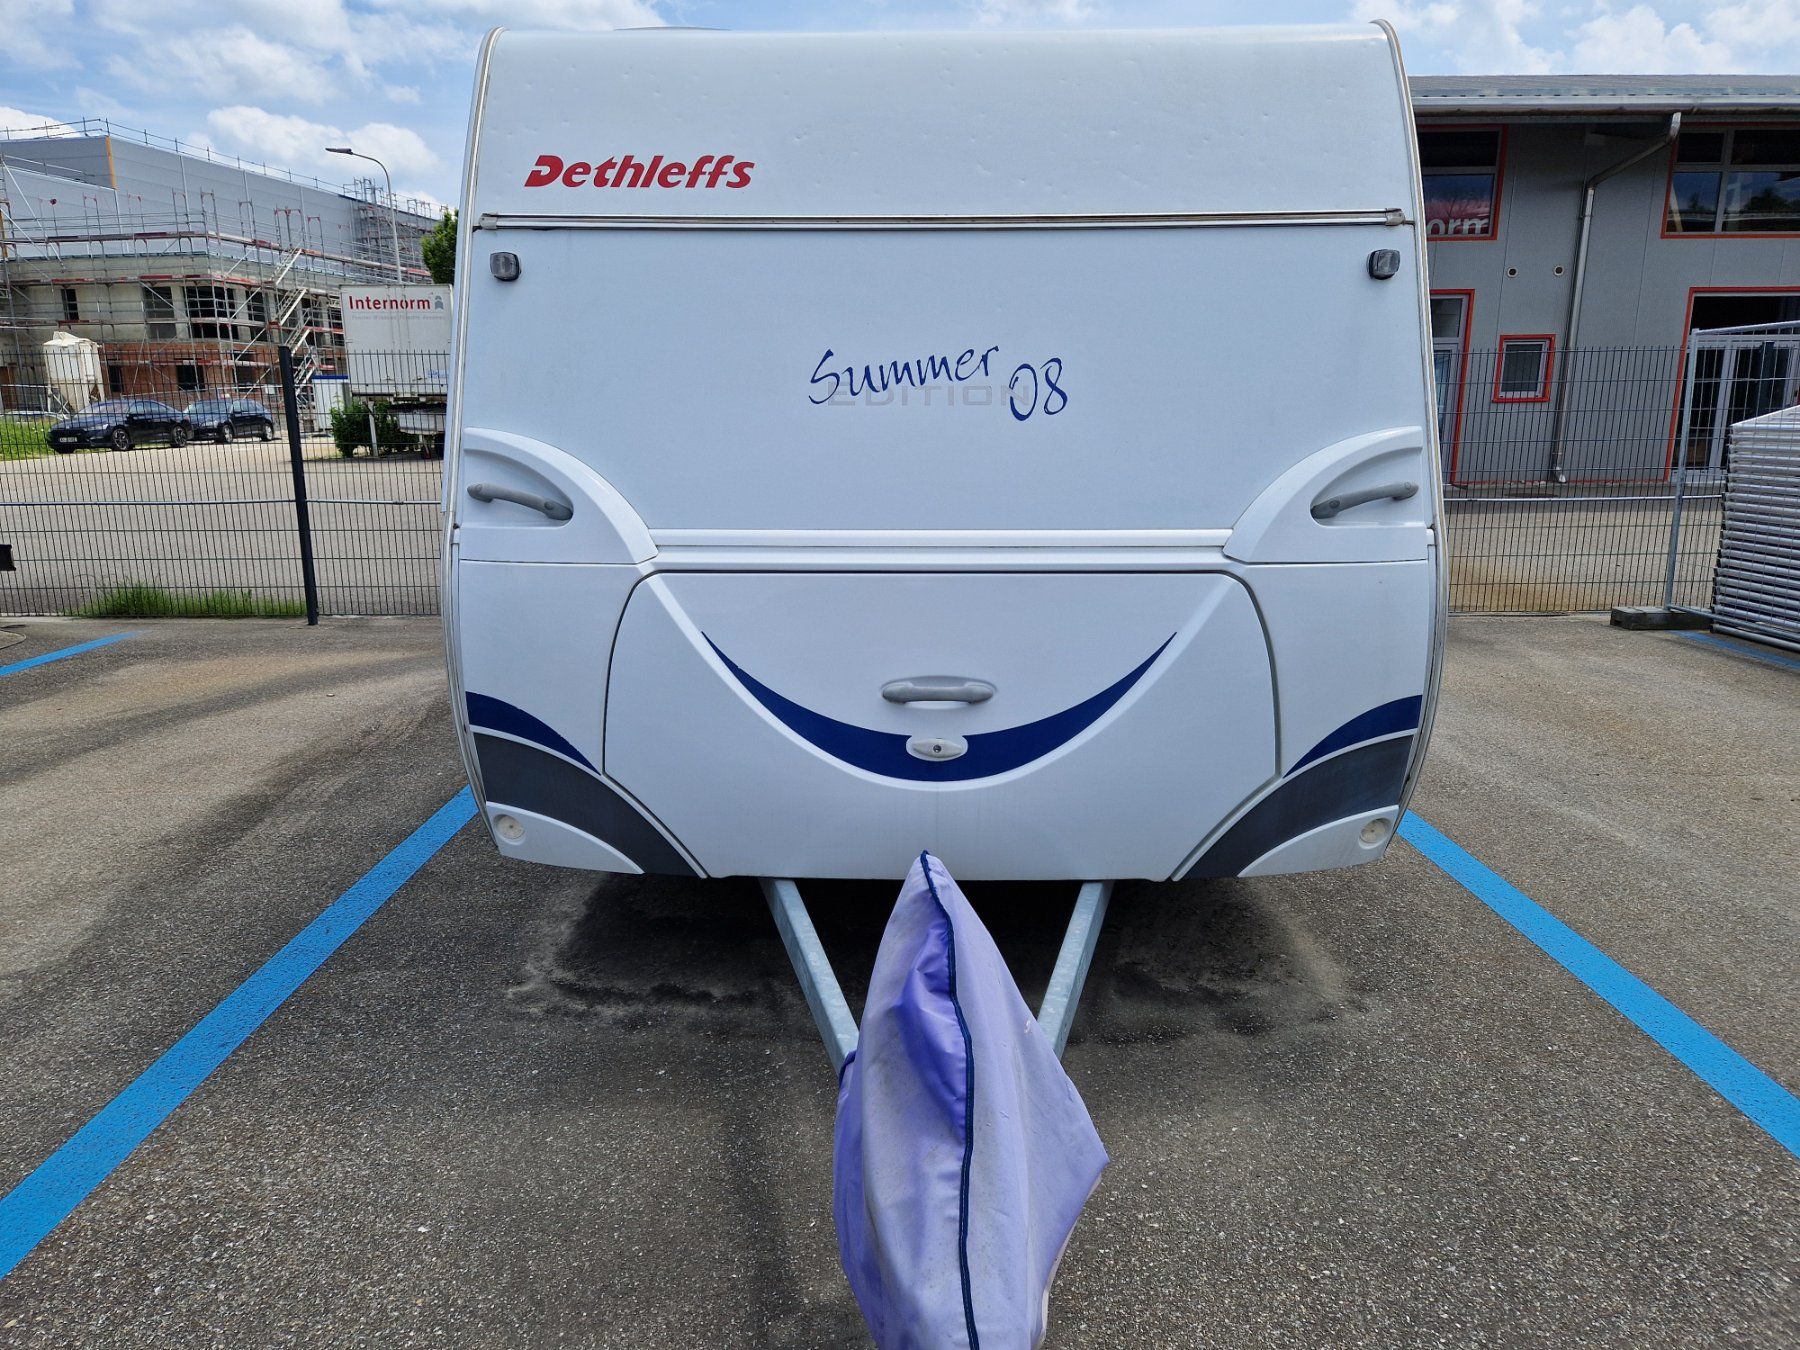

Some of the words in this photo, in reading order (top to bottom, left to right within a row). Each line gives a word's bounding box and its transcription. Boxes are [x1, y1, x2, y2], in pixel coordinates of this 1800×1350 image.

[524, 154, 756, 189] Dethleffs
[348, 295, 431, 310] Internorm
[808, 345, 1000, 405] Summer
[1008, 357, 1068, 421] 08
[827, 381, 1030, 406] EDITION
